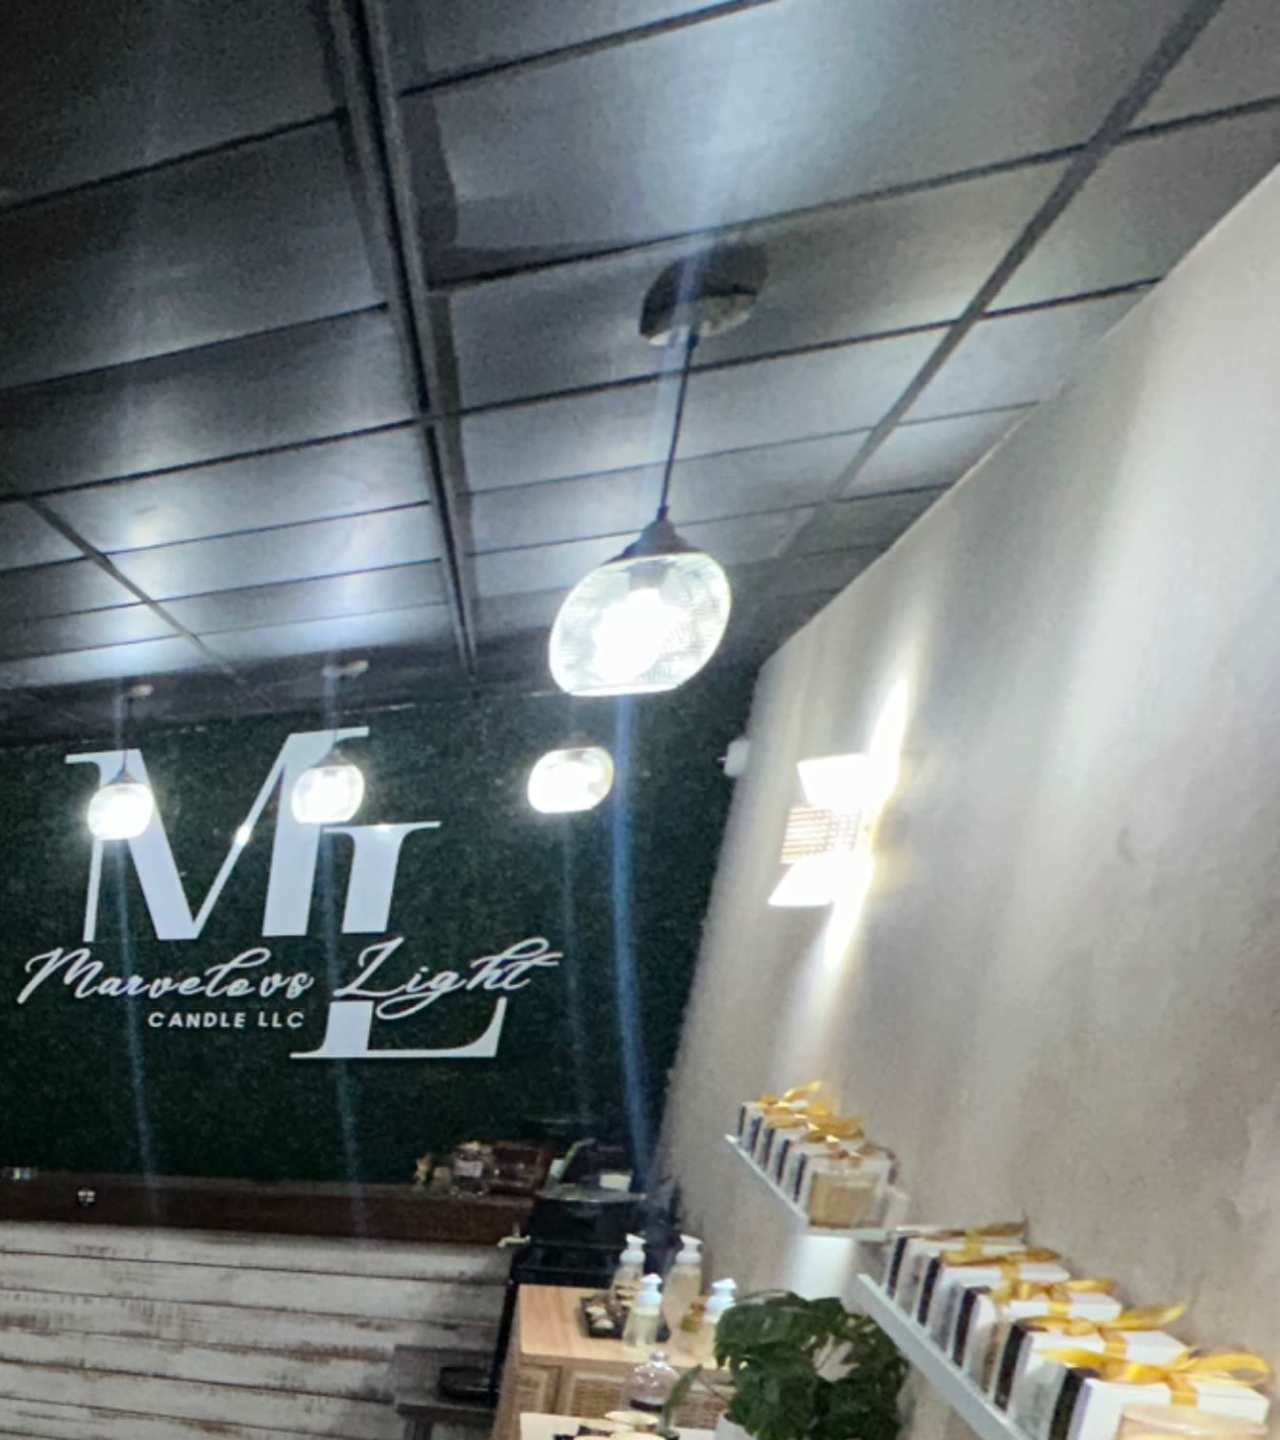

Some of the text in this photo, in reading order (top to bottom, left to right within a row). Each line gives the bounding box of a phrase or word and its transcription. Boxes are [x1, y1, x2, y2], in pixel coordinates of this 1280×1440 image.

[332, 936, 563, 1021] Light
[147, 1011, 305, 1029] CANDLE LLC
